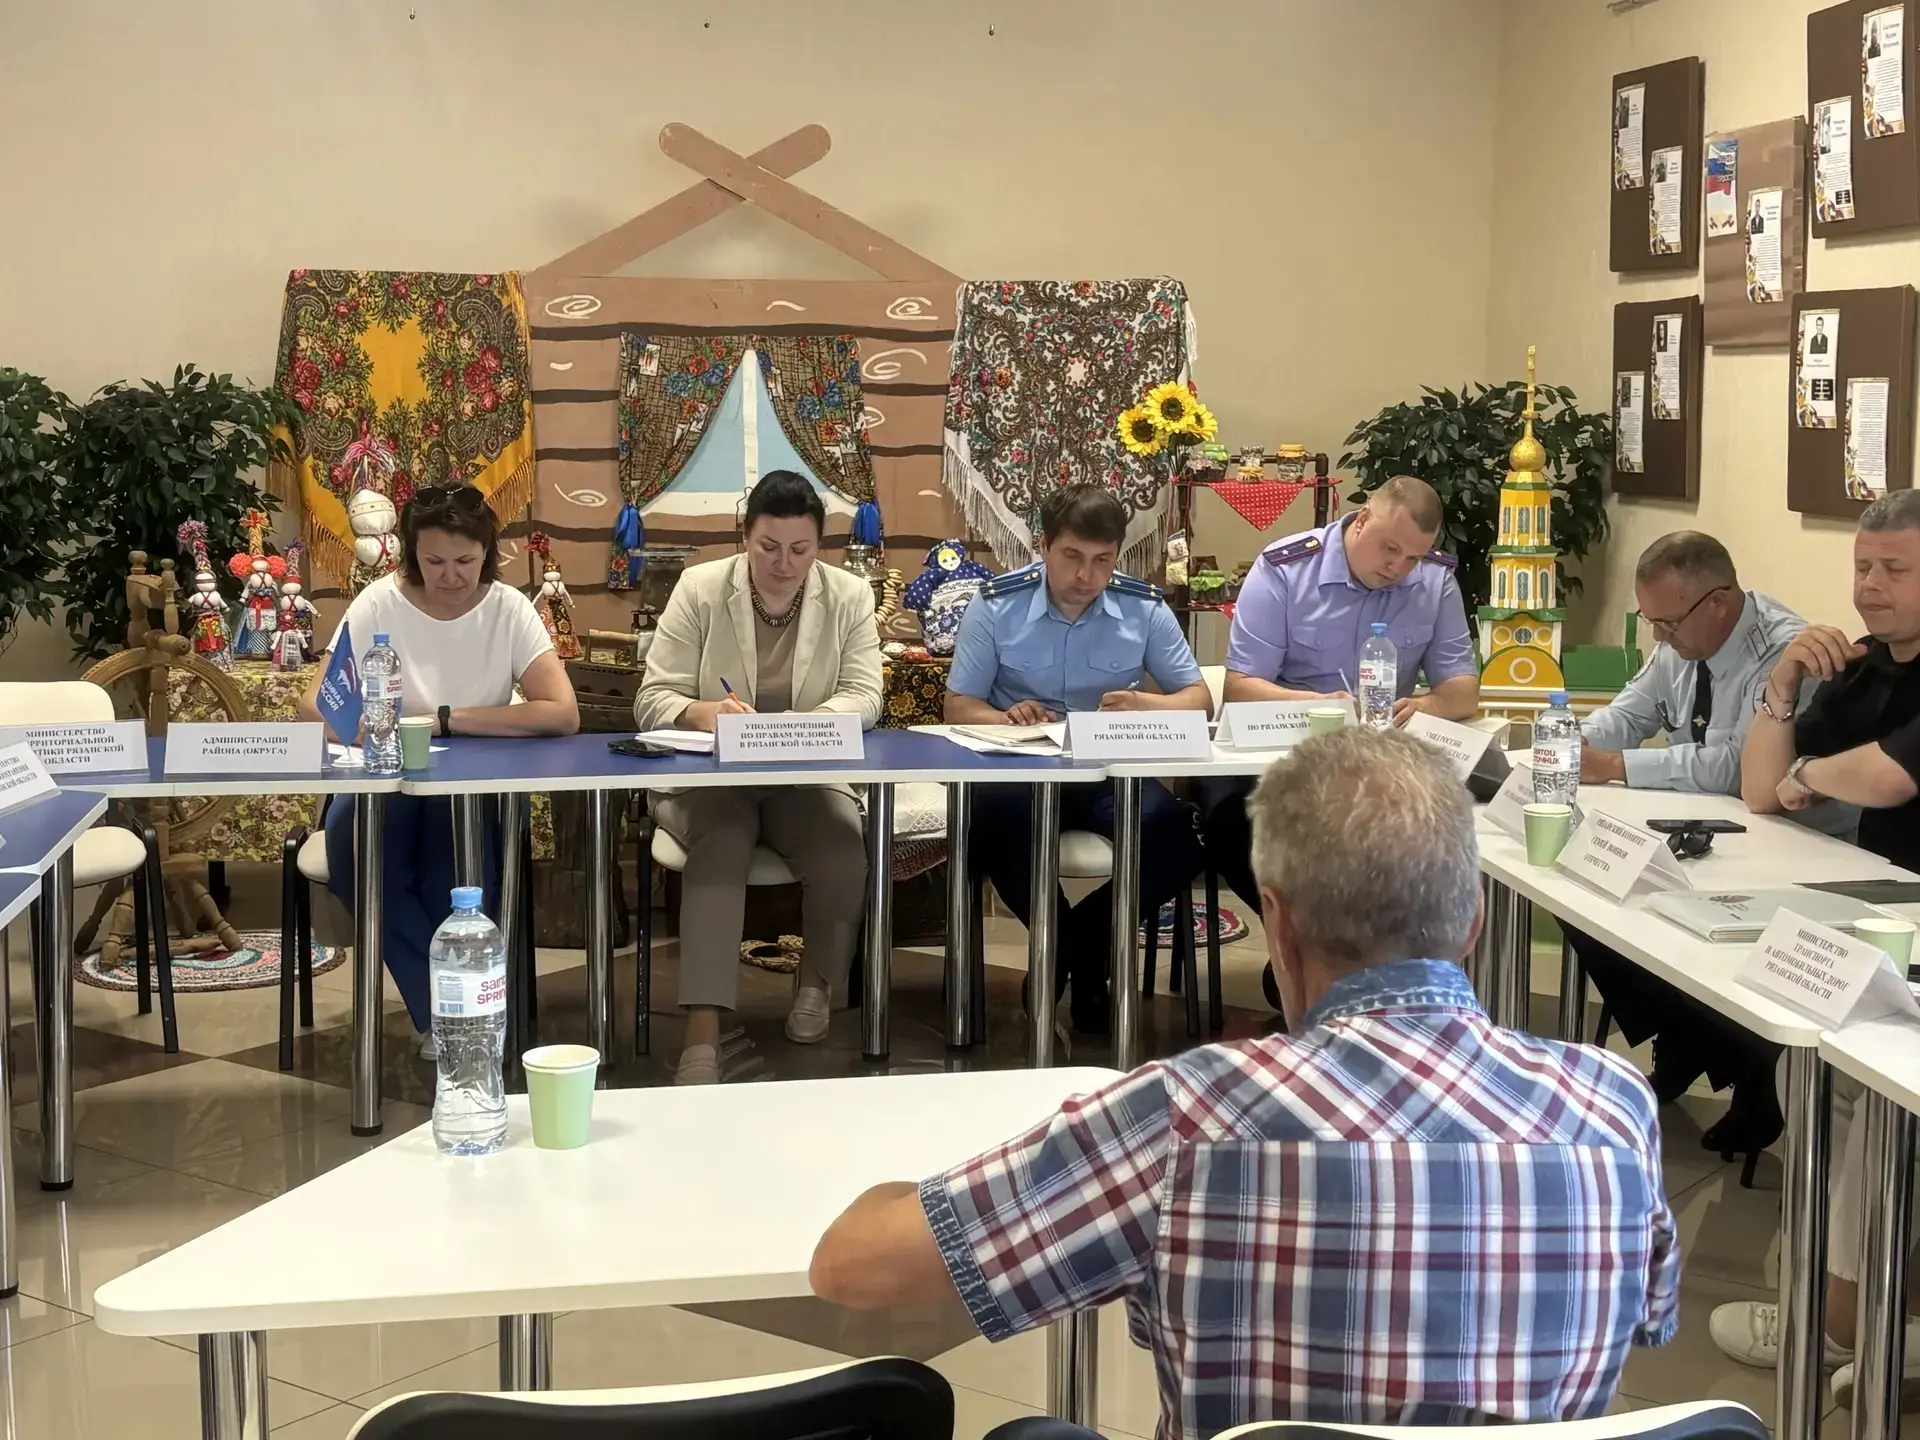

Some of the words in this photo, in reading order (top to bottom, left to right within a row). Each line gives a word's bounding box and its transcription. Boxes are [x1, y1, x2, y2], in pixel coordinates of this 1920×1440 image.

[324, 677, 344, 707] ДИНАЯ
[744, 721, 836, 730] УПОЛНОМОЧЕННЫЙ
[25, 728, 106, 738] МИНИСТЕРСТВО
[755, 731, 793, 739] ПРАВАМ
[794, 730, 841, 738] ЧЕЛОВЕКА
[1094, 731, 1145, 741] РЯЗАНСКОЙ
[1145, 733, 1186, 741] ОБЛАСТИ
[28, 735, 115, 747] РРИТОРИАЛЬНОЙ
[202, 736, 289, 744] АДМИНИСТРАЦИЯ
[747, 739, 800, 748] РЯЗАНСКОЙ
[802, 739, 843, 747] ОБЛАСТИ
[66, 743, 125, 755] РЯЗАНСКОЙ
[202, 746, 241, 755] РАЙОНА
[243, 747, 287, 755] (ОКРУГА)
[1533, 747, 1556, 757] ВЯТОЙ
[44, 756, 91, 765] ОБЛАСТИ
[1796, 928, 1849, 958] МИНИСТЕРСТВО
[1792, 943, 1835, 969] ТРАНСПОРТА
[1764, 945, 1773, 955] И
[1772, 947, 1826, 983] АВТОМОБИЛЬНЫХ
[1823, 974, 1850, 992] ДОРОГ
[1764, 960, 1804, 988] РЯЗАНСКОЙ
[1800, 978, 1833, 1000] ОБЛАСТИ
